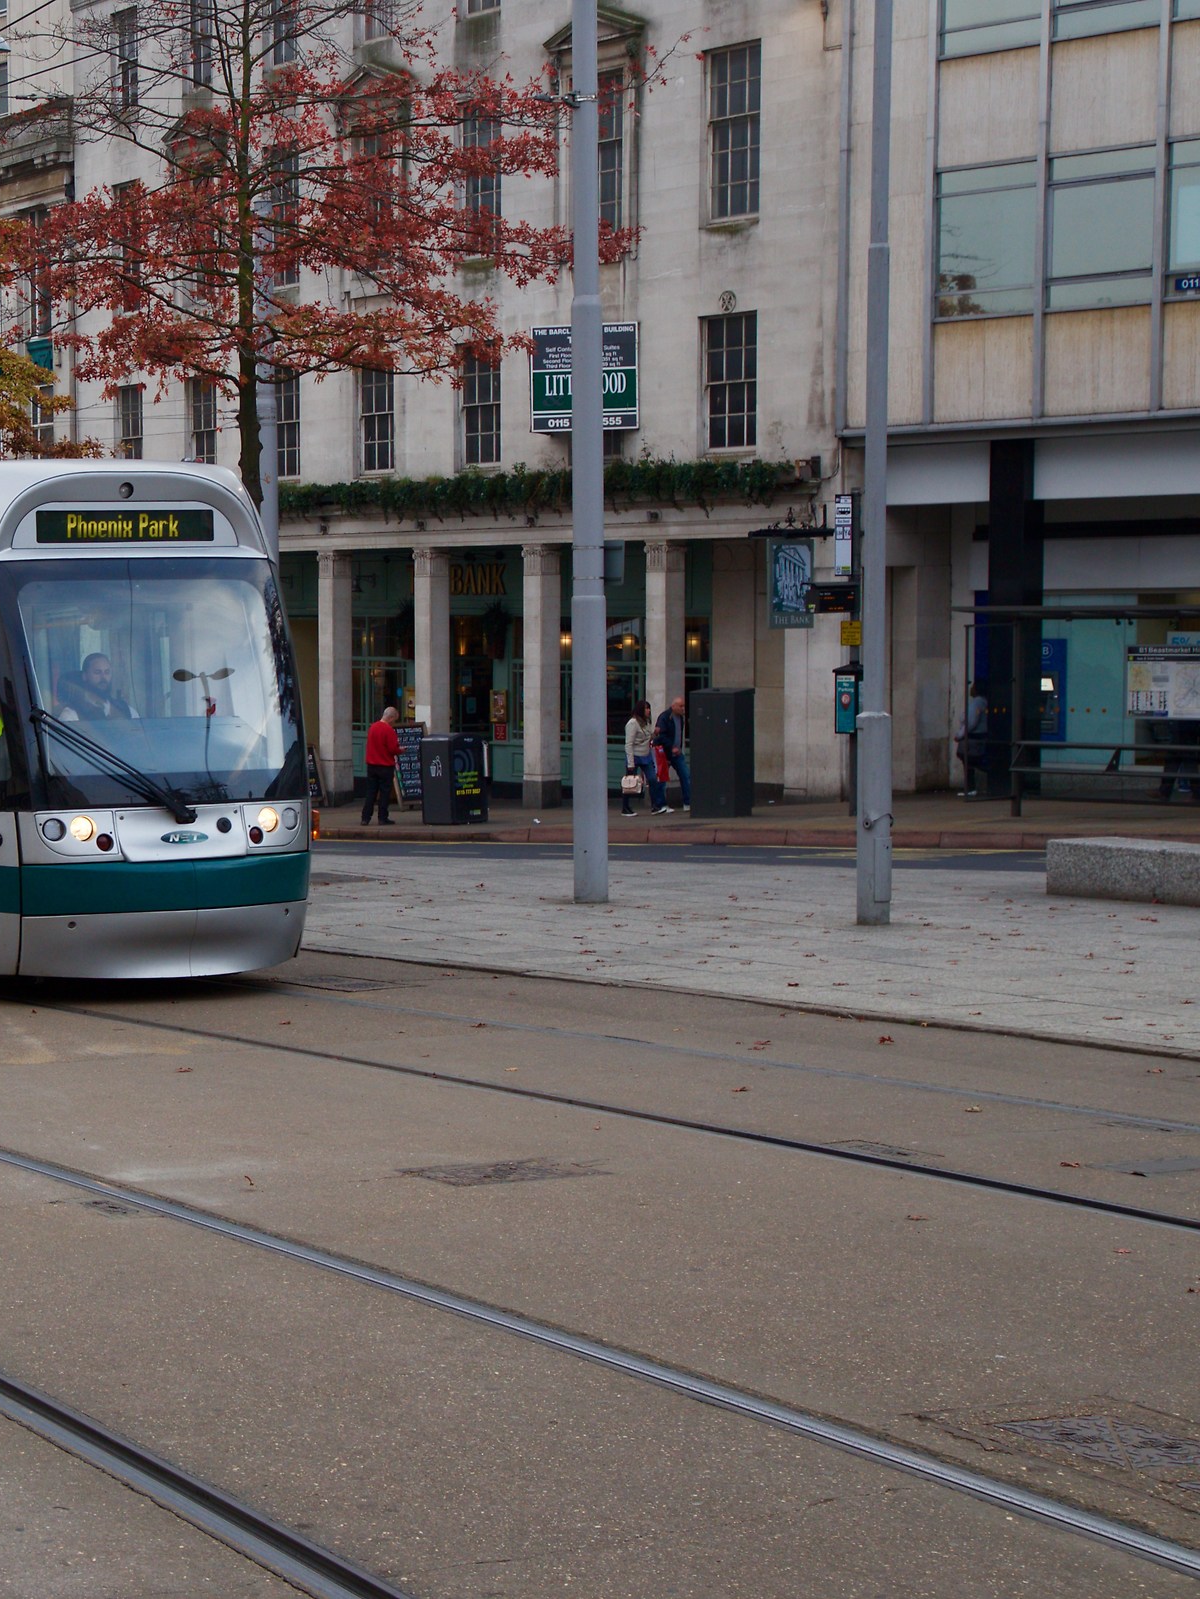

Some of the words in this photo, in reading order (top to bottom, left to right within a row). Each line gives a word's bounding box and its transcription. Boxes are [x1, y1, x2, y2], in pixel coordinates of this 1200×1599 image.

[1182, 279, 1200, 288] 011
[545, 372, 626, 396] LITTOOD
[548, 419, 570, 427] 0115
[67, 513, 132, 538] Phoenix
[139, 513, 179, 538] Park
[450, 563, 507, 595] BANK
[774, 615, 789, 624] THE
[790, 615, 810, 624] BANK
[169, 833, 201, 842] NET
